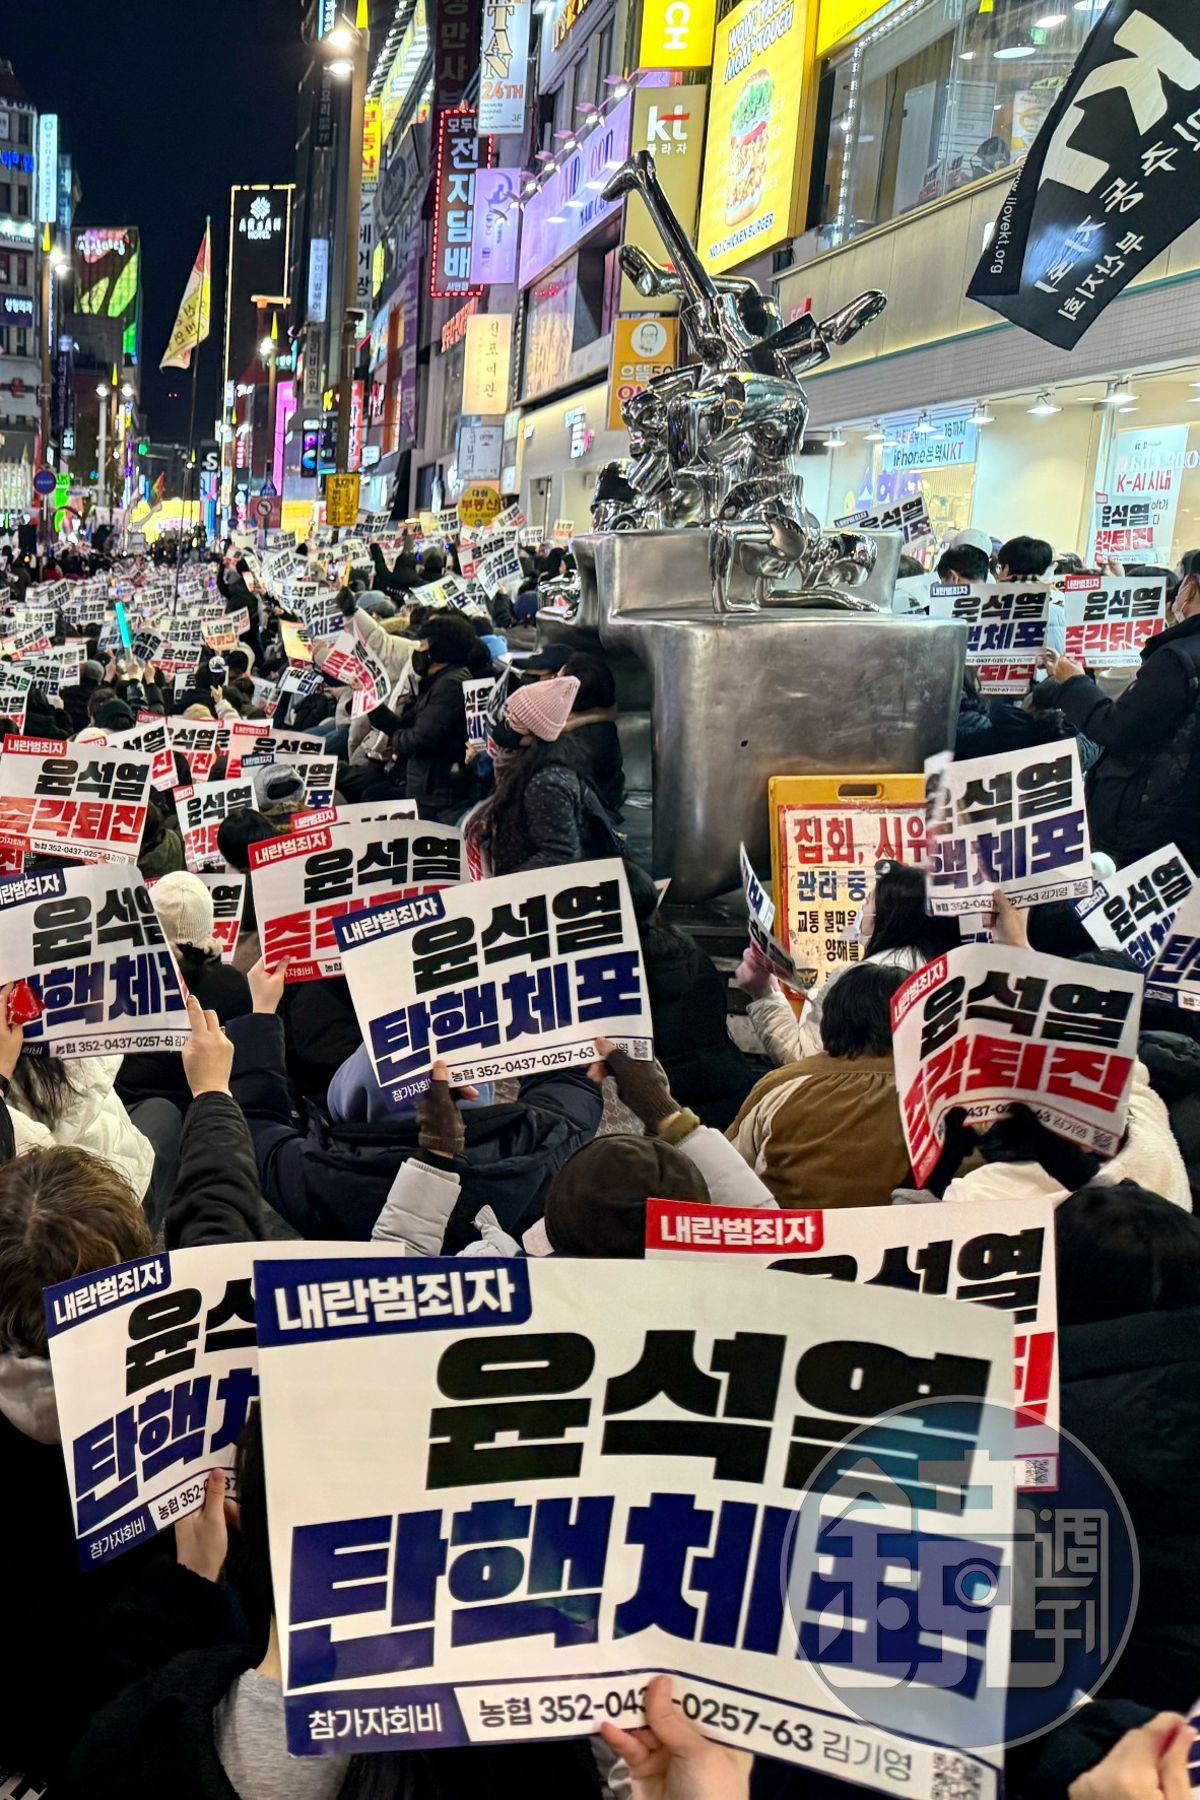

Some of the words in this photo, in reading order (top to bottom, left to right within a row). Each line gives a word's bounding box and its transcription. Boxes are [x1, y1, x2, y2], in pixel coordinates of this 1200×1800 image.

[483, 5, 514, 79] TAN
[756, 4, 795, 57] TOUCH
[481, 83, 524, 99] 24TH
[511, 114, 522, 122] 3F
[646, 104, 690, 142] kt
[721, 228, 749, 255] CHICKEN
[747, 212, 775, 239] BURGER
[1116, 472, 1146, 493] K-AI
[1147, 469, 1172, 493] 시대
[1101, 503, 1151, 528] 윤석열
[1066, 578, 1101, 591] 내란범죄자
[1082, 585, 1161, 622] 윤석열
[952, 591, 1048, 622] 윤석열
[7, 740, 64, 754] 내란범죄자
[34, 758, 151, 801] 윤석열
[33, 840, 48, 851] 농협
[254, 831, 329, 868] 내란범죄자
[793, 817, 865, 865] 집회,
[302, 834, 462, 905] 윤석열
[1040, 885, 1069, 900] 김기영
[1103, 856, 1192, 944] 윤석열
[341, 897, 439, 945] 내란범죄자
[410, 879, 625, 995] 윤석열
[797, 911, 819, 933] 교통
[367, 950, 643, 1086] 탄핵체포
[919, 970, 1135, 1062] 윤석열
[55, 1040, 77, 1055] 농협
[78, 1035, 174, 1052] 352-0437-0257-63
[449, 1067, 476, 1083] 농협
[475, 1045, 596, 1079] 352-0437-0257-63
[659, 1210, 817, 1250] 내란범죄자
[53, 1259, 165, 1326] 내란범죄자
[274, 1268, 518, 1333] 내란범죄자
[423, 1328, 993, 1515] 윤석열
[88, 1516, 147, 1560] 참가자회비
[158, 1497, 180, 1522] 농협
[285, 1491, 1008, 1700] 탄핵체포
[307, 1701, 445, 1744] 참가자회비
[477, 1695, 535, 1731] 농협
[819, 1728, 913, 1784] 김기영
